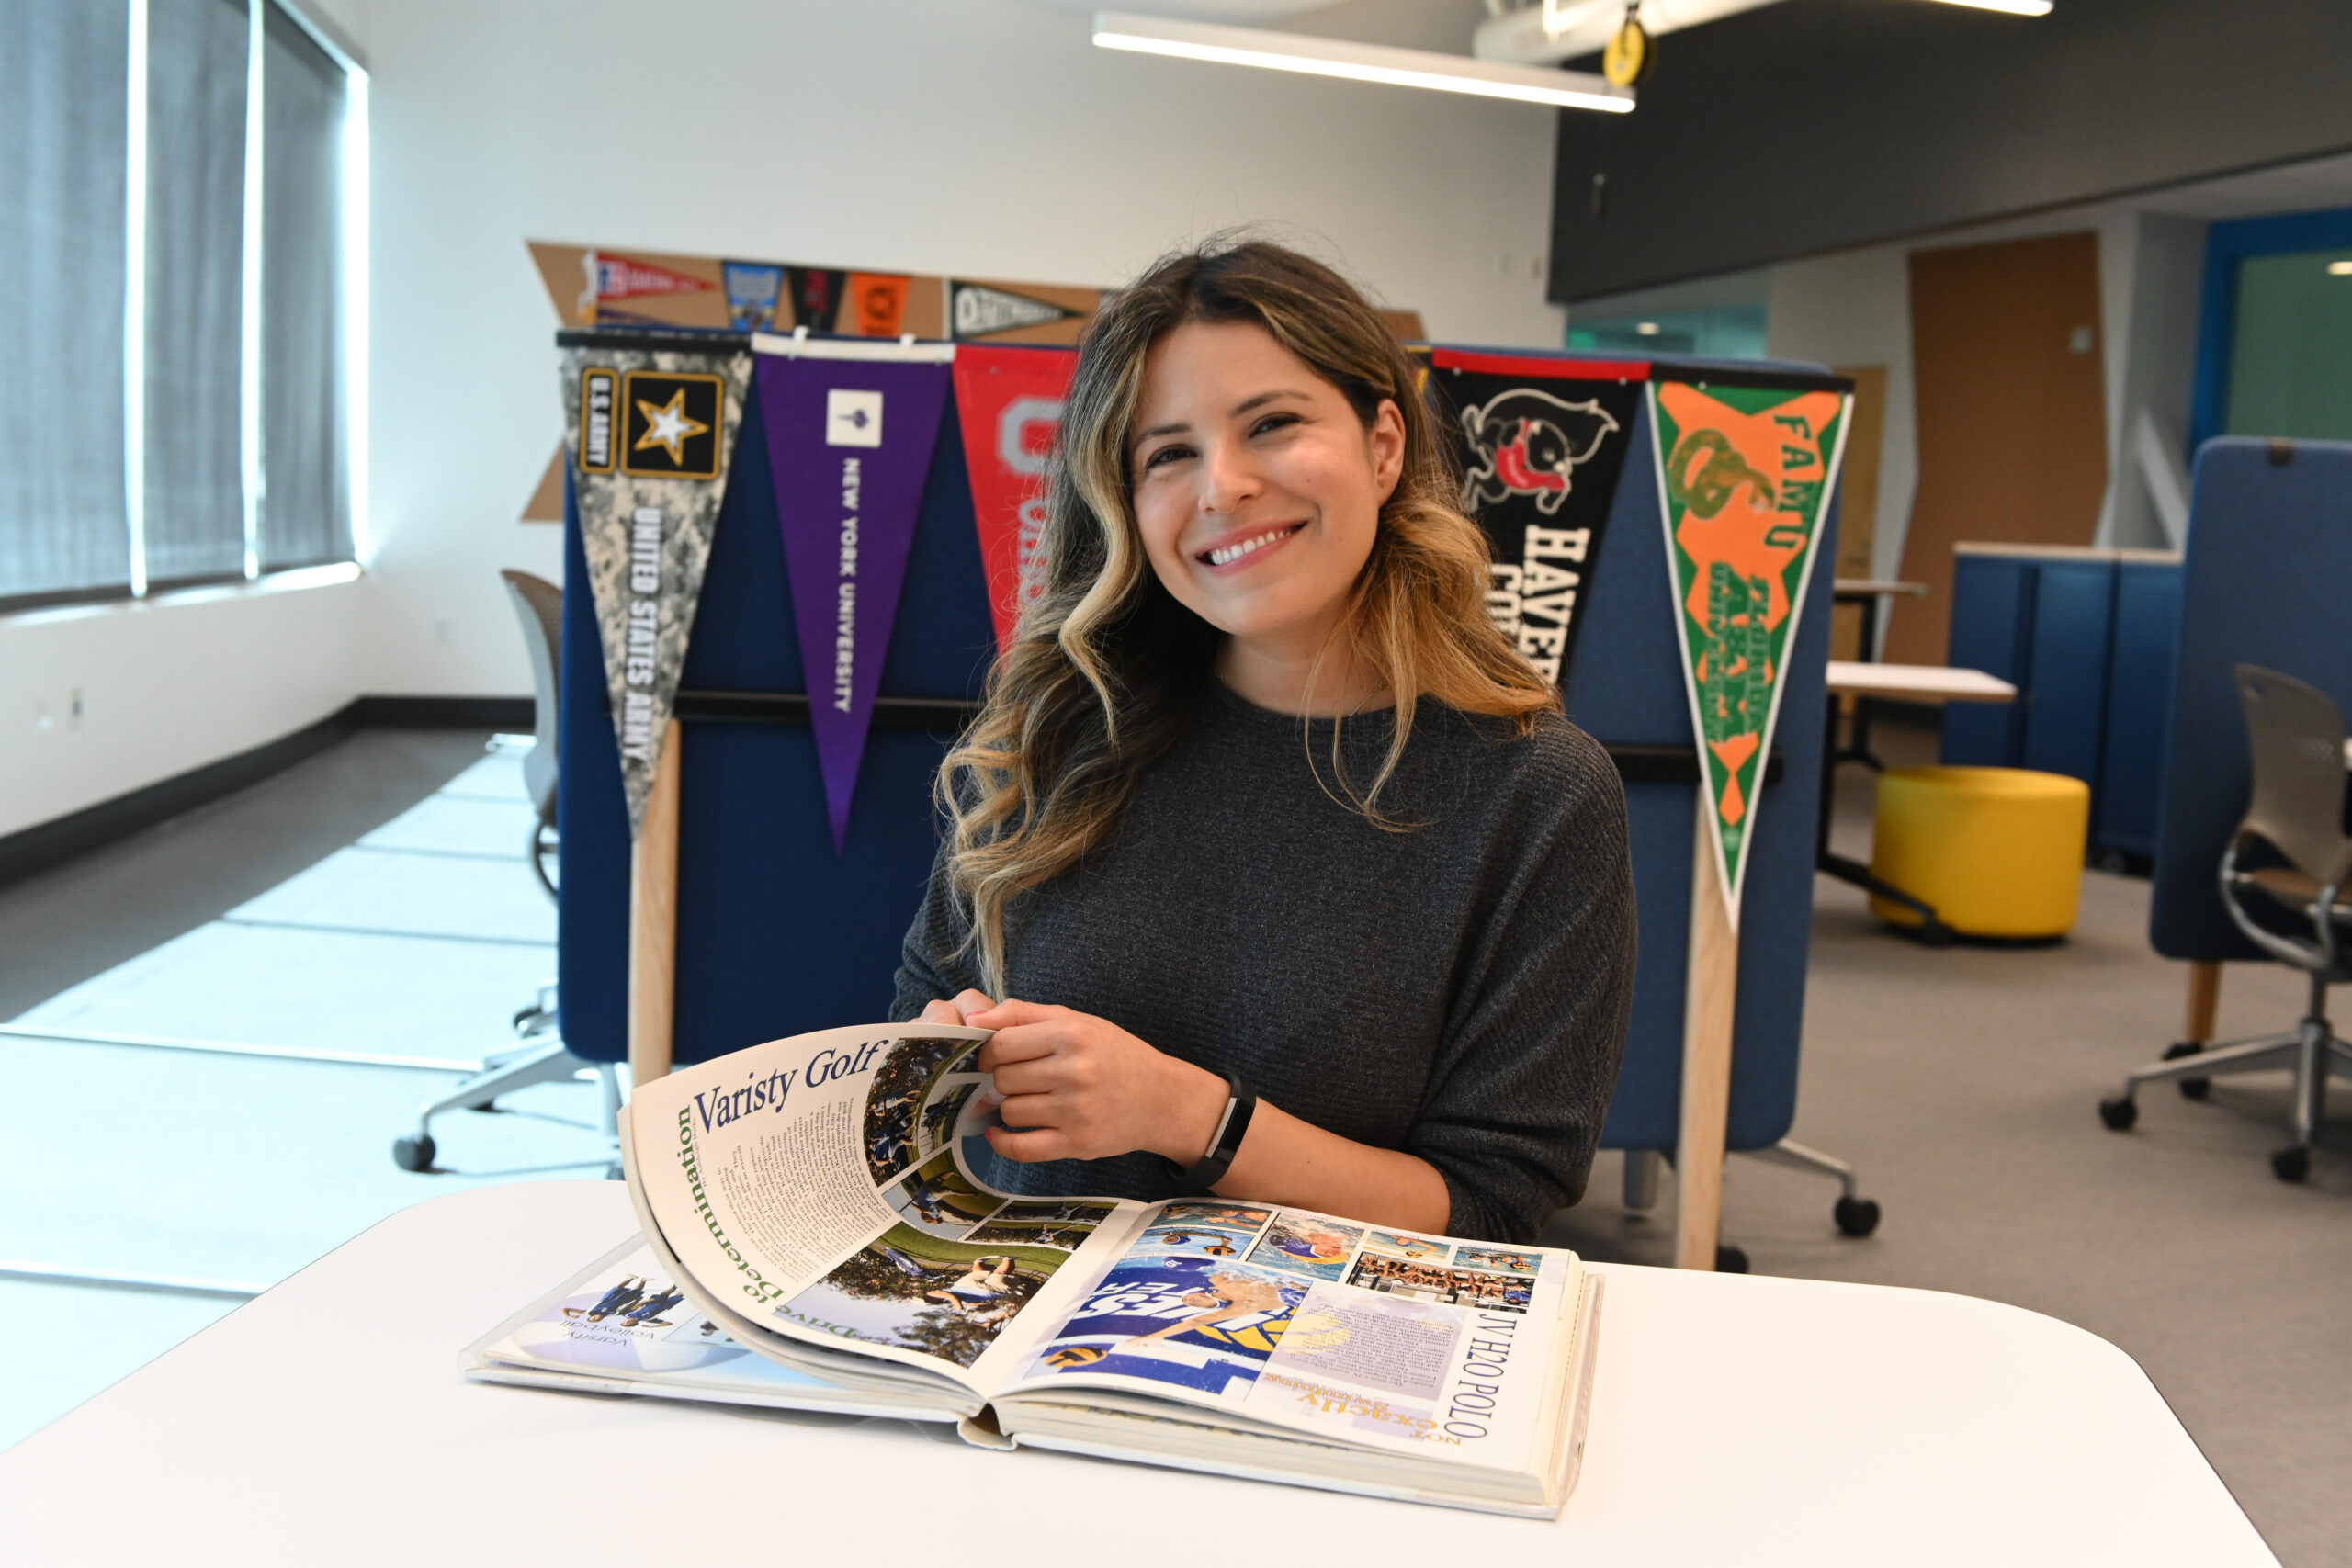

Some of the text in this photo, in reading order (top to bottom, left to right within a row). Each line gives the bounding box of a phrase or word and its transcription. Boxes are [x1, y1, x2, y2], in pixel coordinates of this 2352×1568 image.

[1764, 413, 1818, 549] FAMU
[833, 457, 861, 714] NEW YORK UNIVERSITY
[621, 507, 662, 762] UNITED STATES ARMY
[694, 1040, 888, 1134] Varisty Golf
[675, 1104, 788, 1308] Determination
[559, 1320, 654, 1340] Volleyball
[564, 1331, 628, 1348] Varsity
[1478, 1313, 1519, 1337] JV
[1463, 1339, 1512, 1382] H2O
[1296, 1390, 1439, 1430] exactly
[1443, 1379, 1497, 1439] POLO
[1410, 1429, 1463, 1447] NOT
